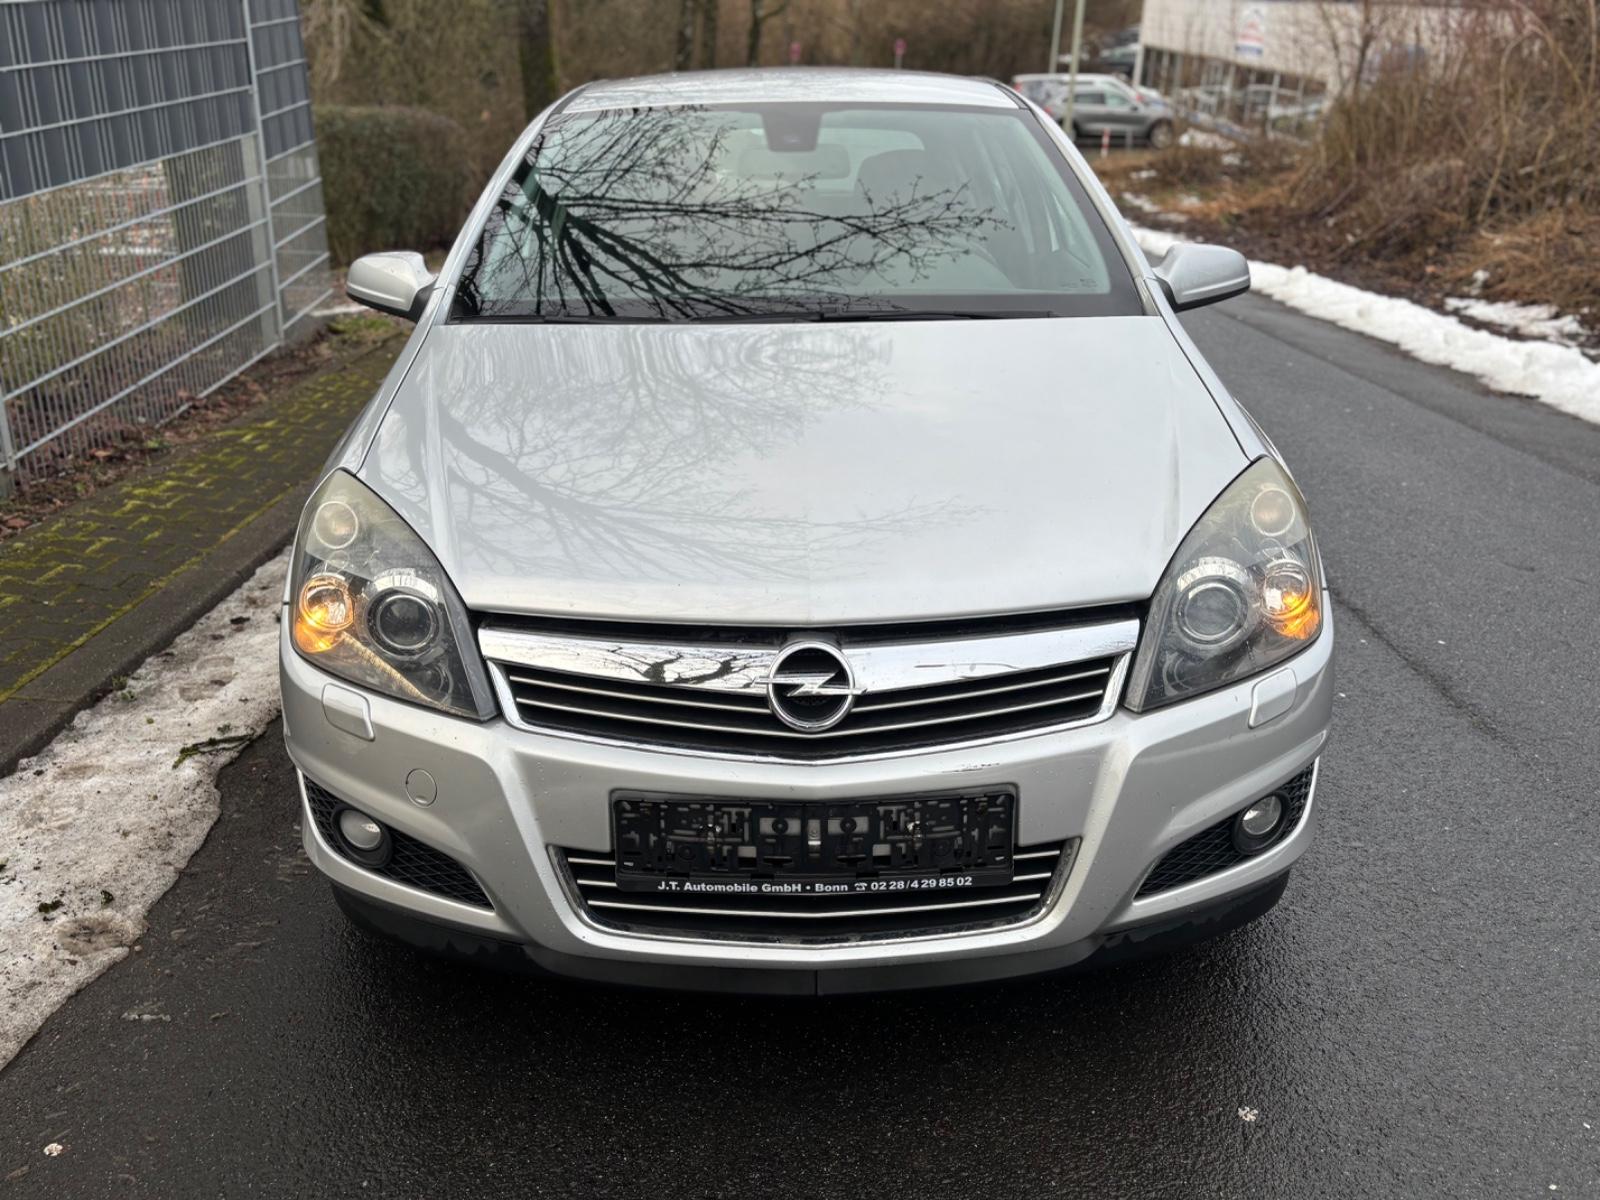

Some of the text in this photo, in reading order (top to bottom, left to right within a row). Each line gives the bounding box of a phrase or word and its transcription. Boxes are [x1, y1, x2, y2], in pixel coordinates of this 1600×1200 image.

[657, 880, 679, 891] J.T.
[684, 881, 758, 892] Automobile
[761, 882, 802, 893] GmbH
[814, 883, 848, 893] Bonn
